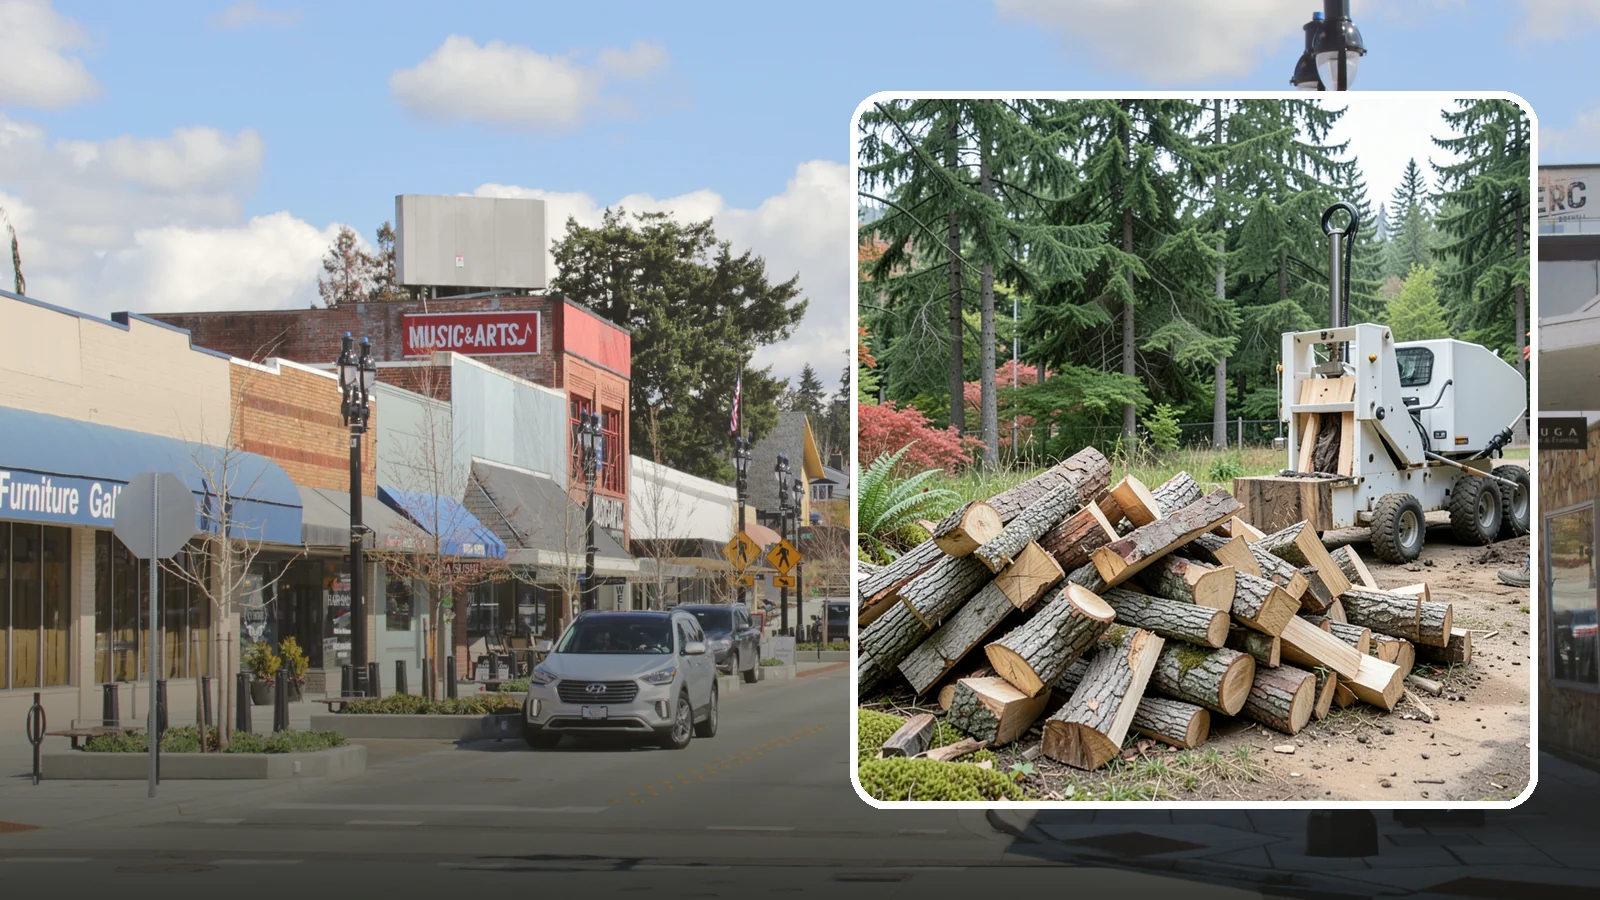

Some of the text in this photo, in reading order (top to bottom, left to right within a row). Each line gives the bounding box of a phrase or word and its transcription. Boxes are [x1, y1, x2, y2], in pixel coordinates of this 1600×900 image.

[409, 322, 519, 349] MUSIC&ARTS
[0, 471, 122, 519] Furniture Gal
